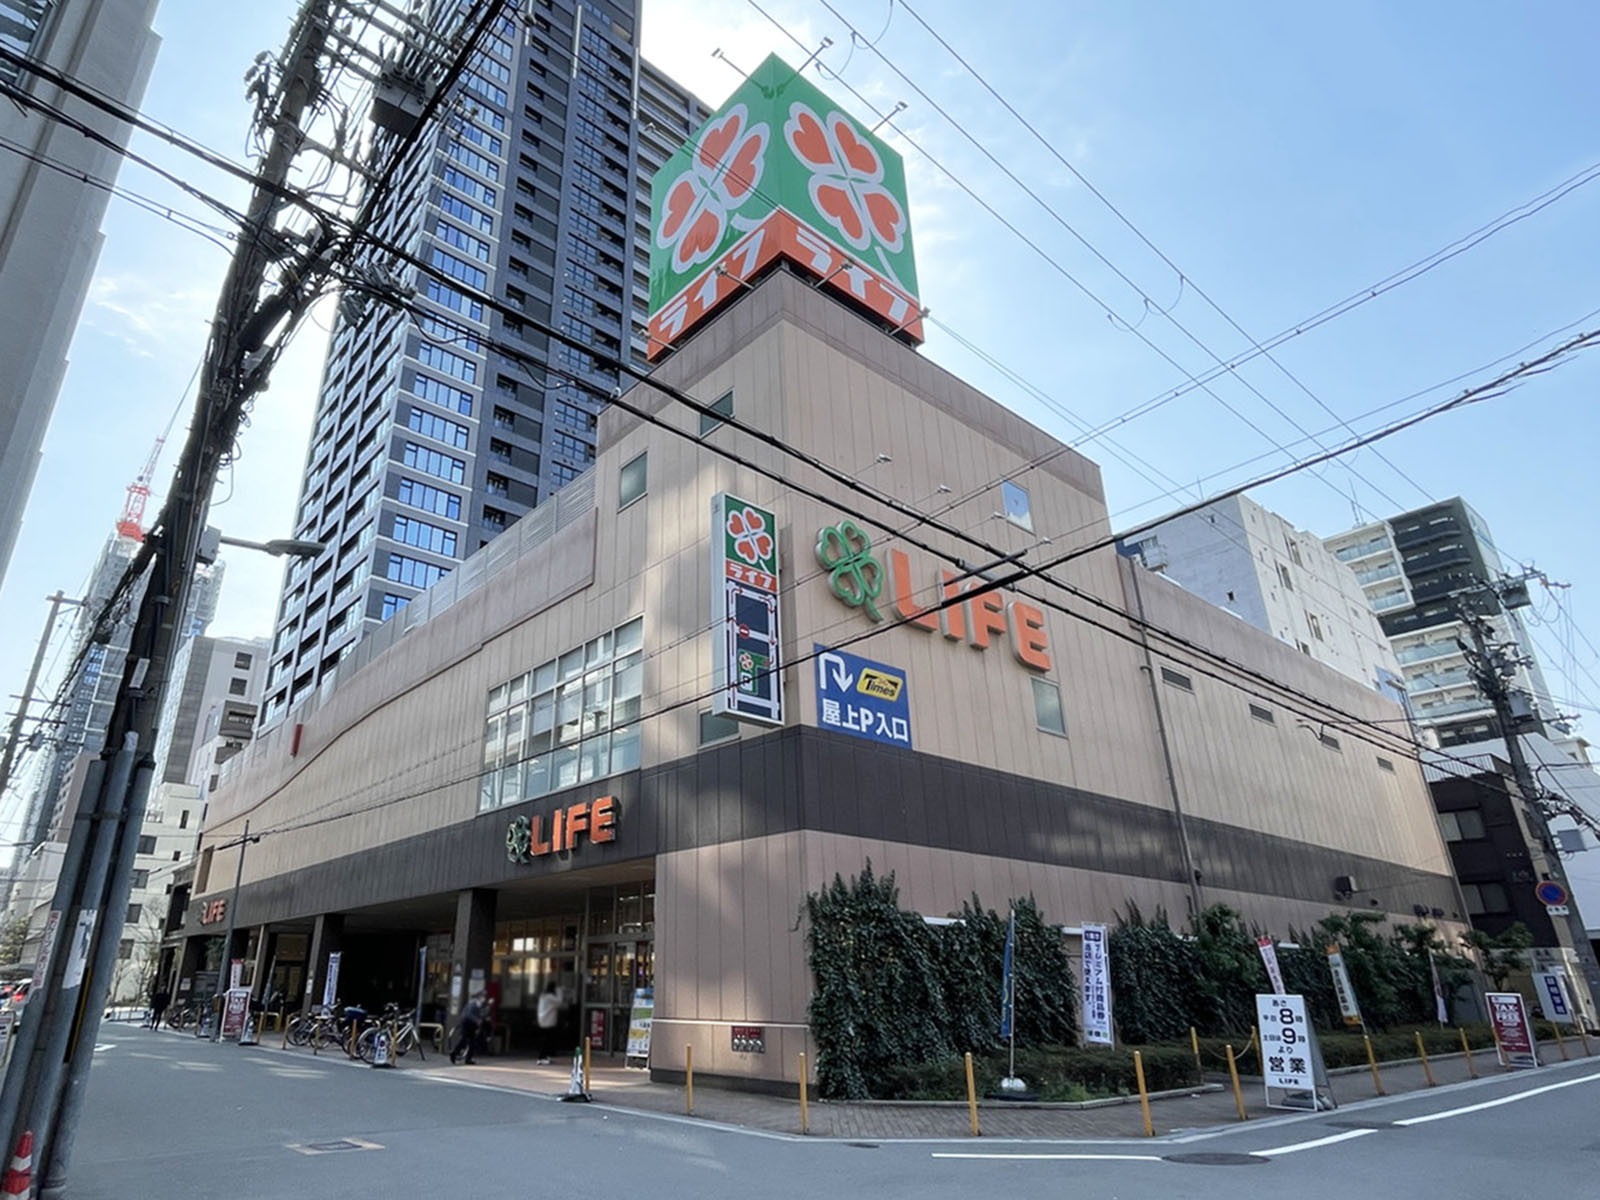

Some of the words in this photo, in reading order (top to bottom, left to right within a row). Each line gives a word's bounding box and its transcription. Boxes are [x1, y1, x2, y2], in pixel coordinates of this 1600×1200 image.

[659, 228, 766, 338] ライフ
[796, 227, 910, 322] ライフ
[729, 561, 772, 589] ライフ
[887, 548, 1051, 673] LIFE
[863, 673, 899, 697] Times
[822, 698, 909, 742] 屋上P入口
[529, 795, 616, 856] LIFE
[1278, 1046, 1294, 1054] より
